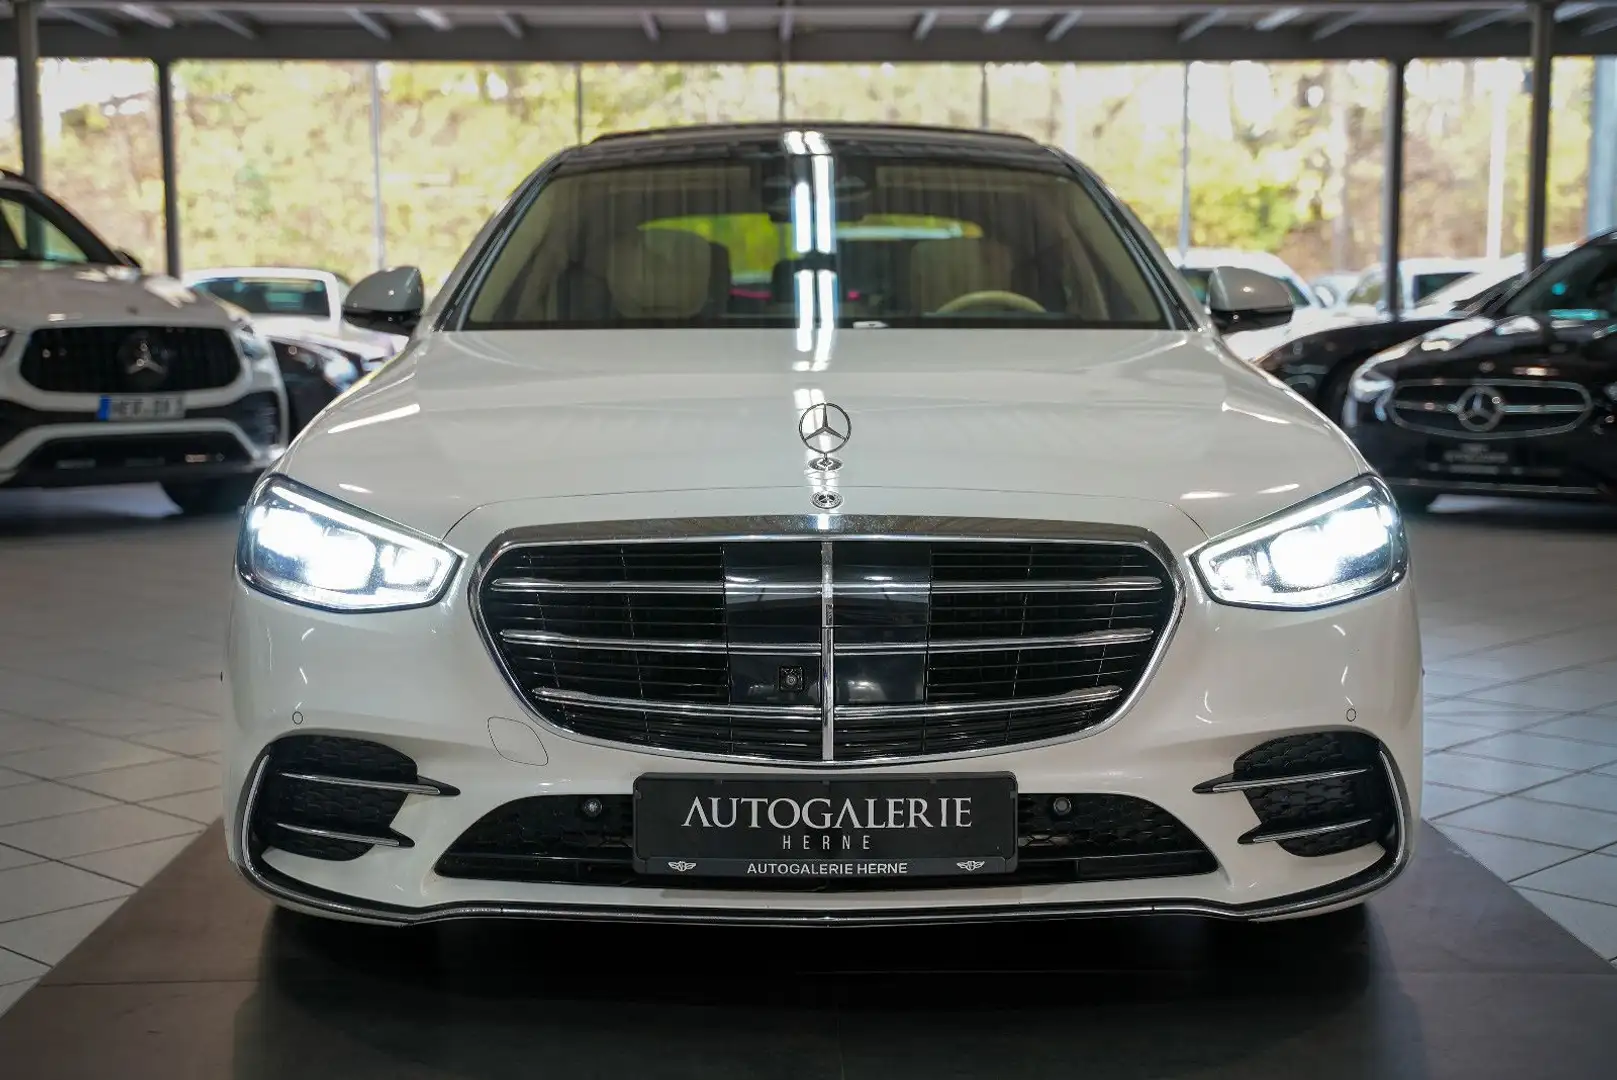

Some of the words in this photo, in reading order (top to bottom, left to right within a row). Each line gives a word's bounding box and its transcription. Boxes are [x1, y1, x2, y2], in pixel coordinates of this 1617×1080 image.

[681, 796, 972, 829] AUTOGALERIE
[782, 835, 871, 850] HERNE
[746, 863, 853, 875] AUTOGALERIE
[857, 862, 908, 874] HERNE
